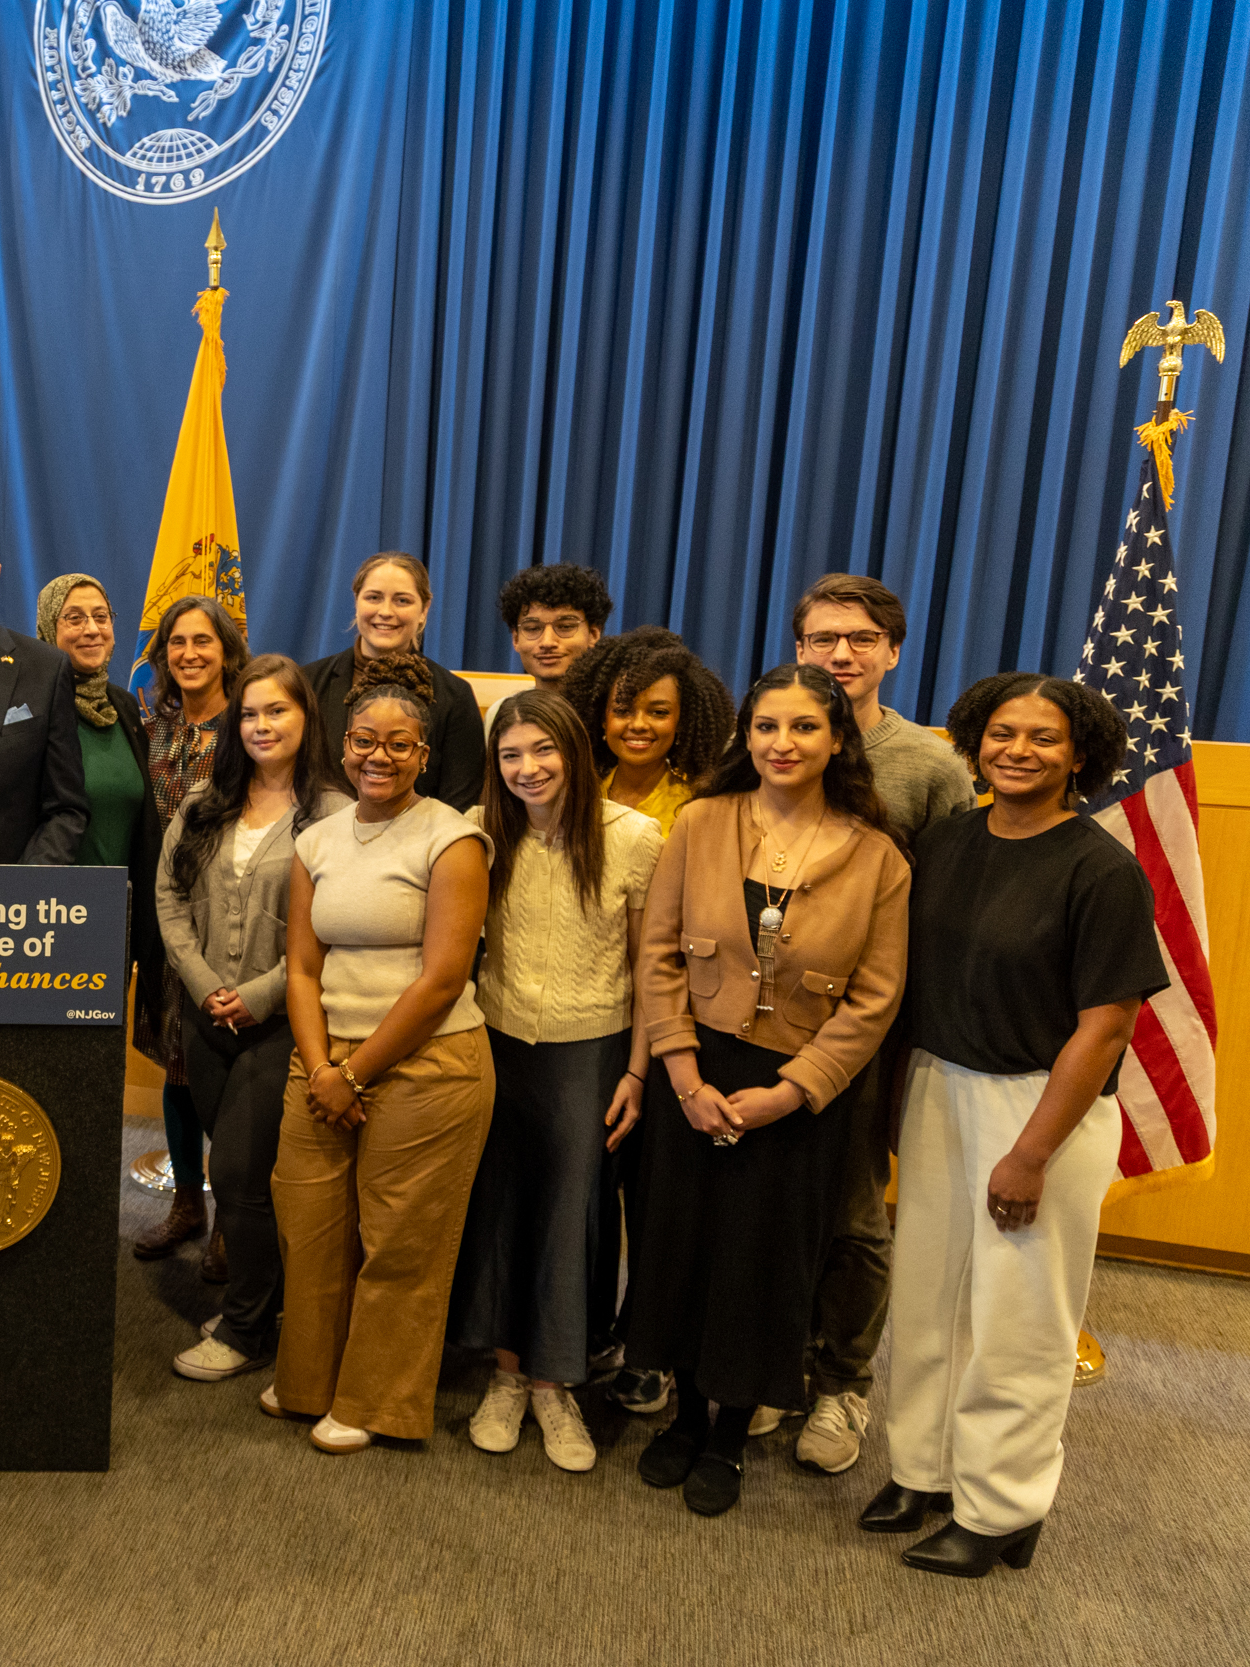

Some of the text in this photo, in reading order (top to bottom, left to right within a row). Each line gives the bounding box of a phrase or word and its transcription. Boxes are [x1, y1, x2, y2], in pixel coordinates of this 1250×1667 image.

[136, 167, 205, 193] 1769
[36, 898, 88, 924] the
[23, 931, 55, 957] of
[66, 1009, 116, 1020] @NJGov
[19, 1110, 35, 1128] OF
[31, 1131, 52, 1166] NEW
